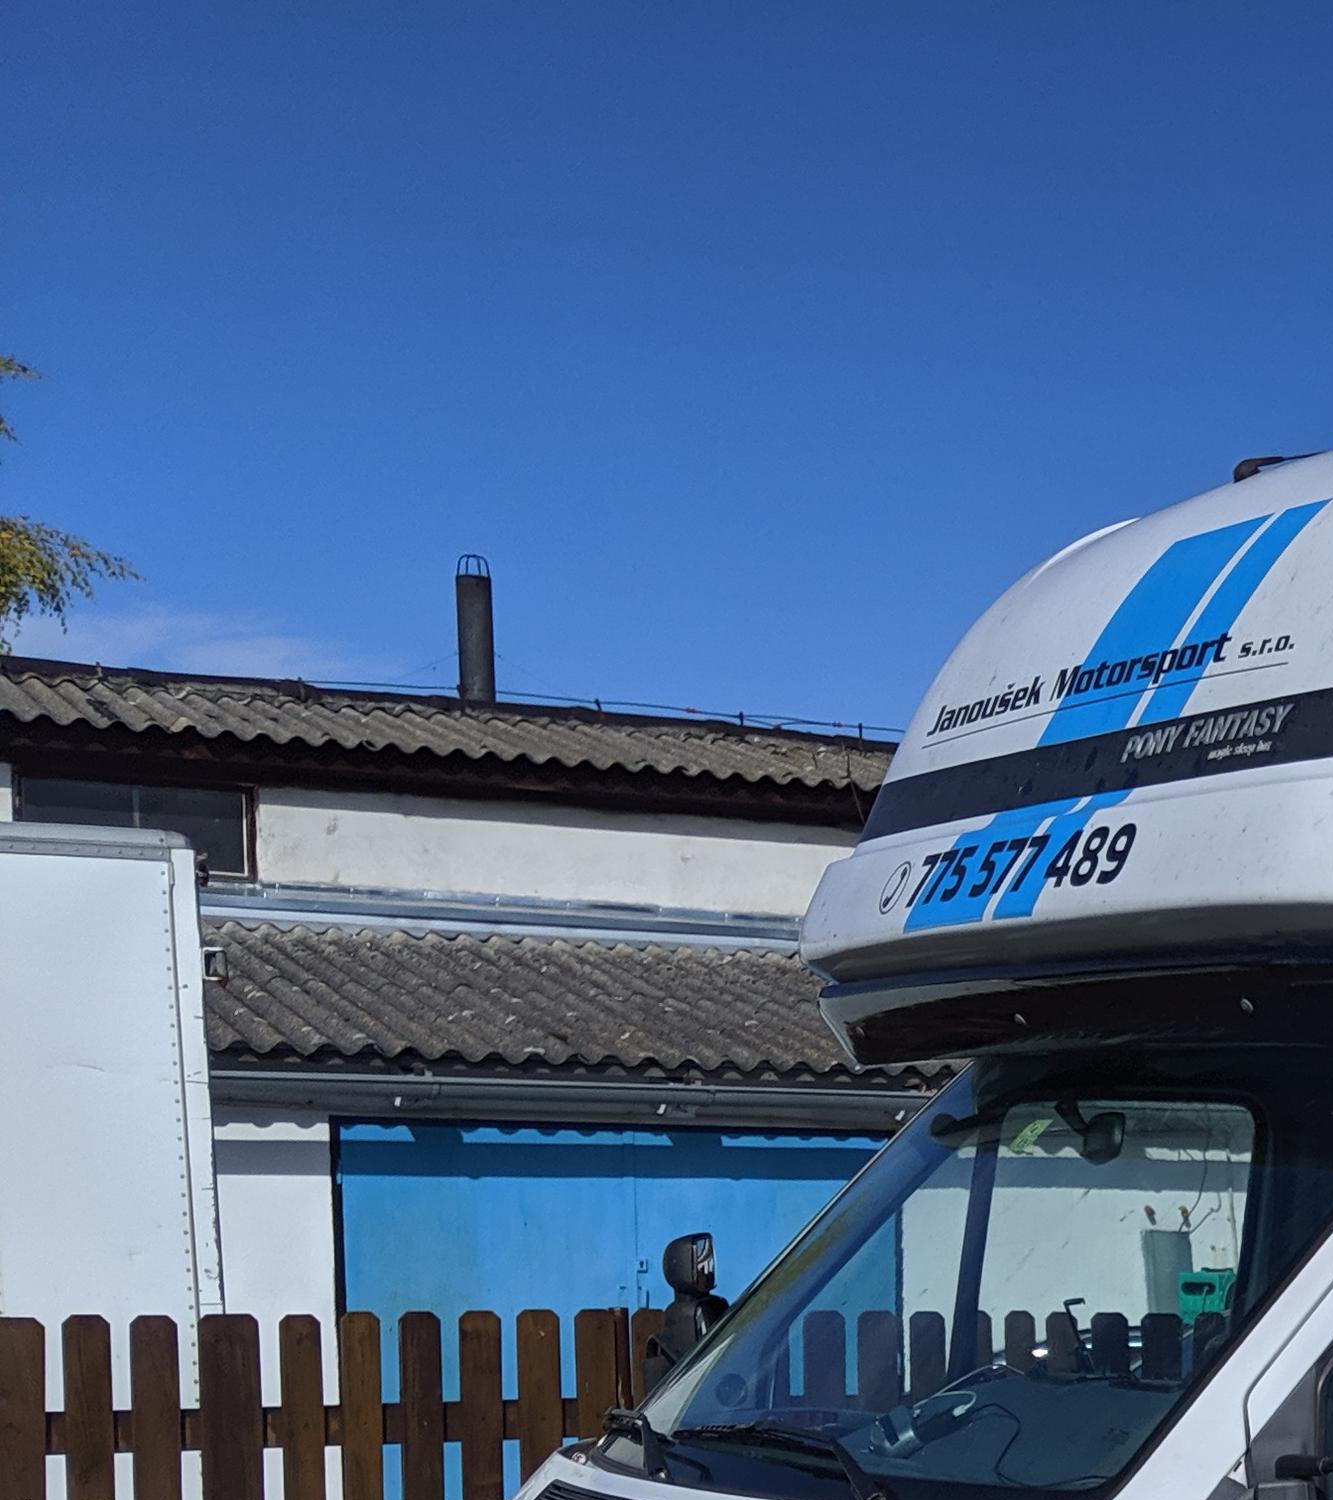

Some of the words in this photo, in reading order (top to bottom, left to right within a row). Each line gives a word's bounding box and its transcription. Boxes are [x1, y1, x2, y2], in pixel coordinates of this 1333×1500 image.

[926, 676, 1046, 737] Janoušek
[1049, 632, 1231, 701] Motorsport
[1238, 635, 1294, 658] s.r.o.
[1120, 723, 1185, 763] PONY
[1182, 703, 1294, 748] FANTASY
[905, 845, 979, 908] 775
[968, 835, 1052, 897] 577
[1044, 823, 1137, 888] 489
